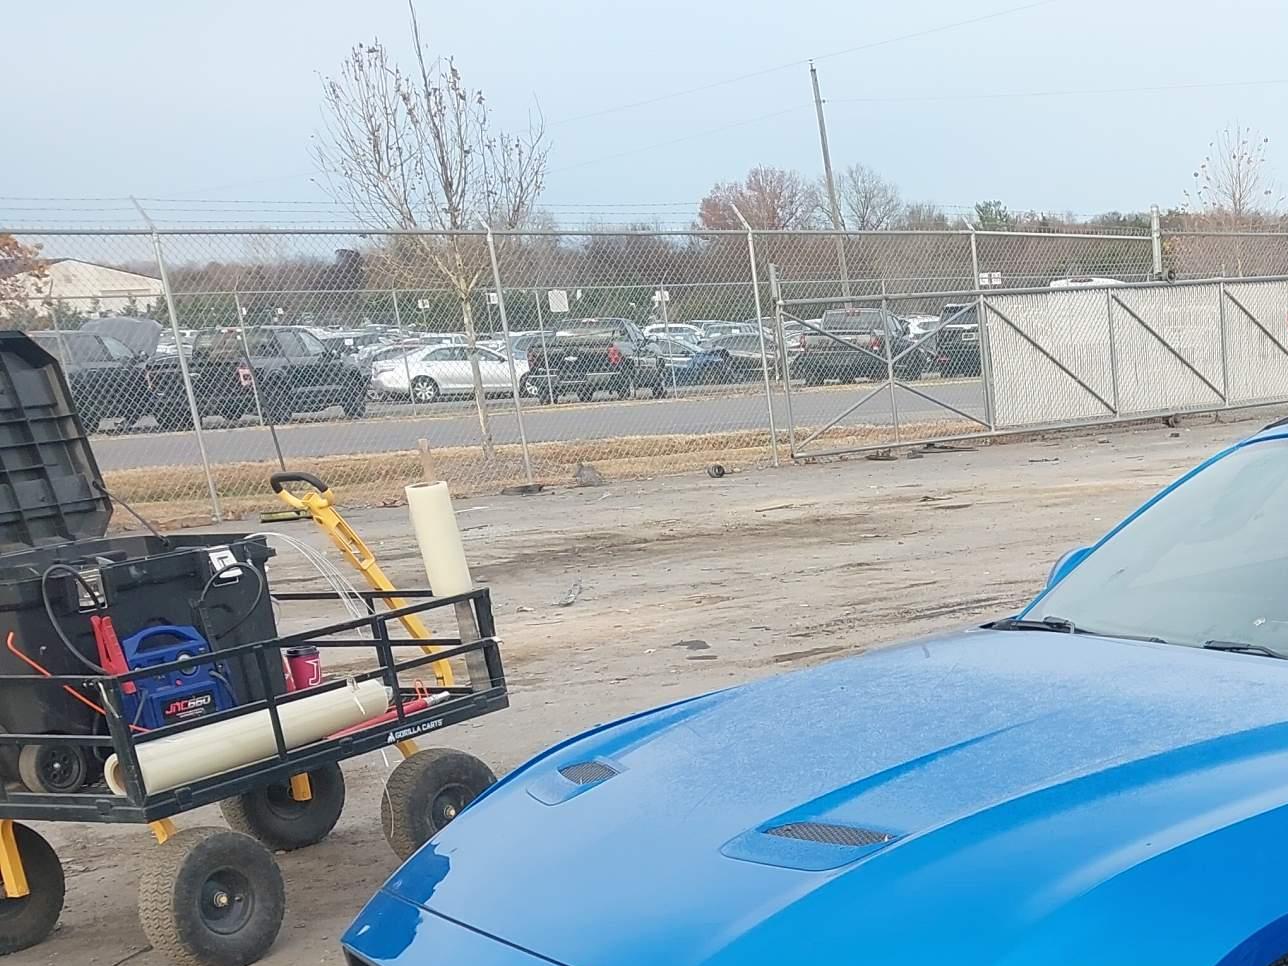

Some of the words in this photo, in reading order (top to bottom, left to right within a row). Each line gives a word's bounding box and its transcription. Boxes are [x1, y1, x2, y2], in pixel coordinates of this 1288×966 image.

[165, 694, 211, 715] JNC660
[394, 725, 421, 739] GORILLA
[421, 718, 443, 731] CARTS
